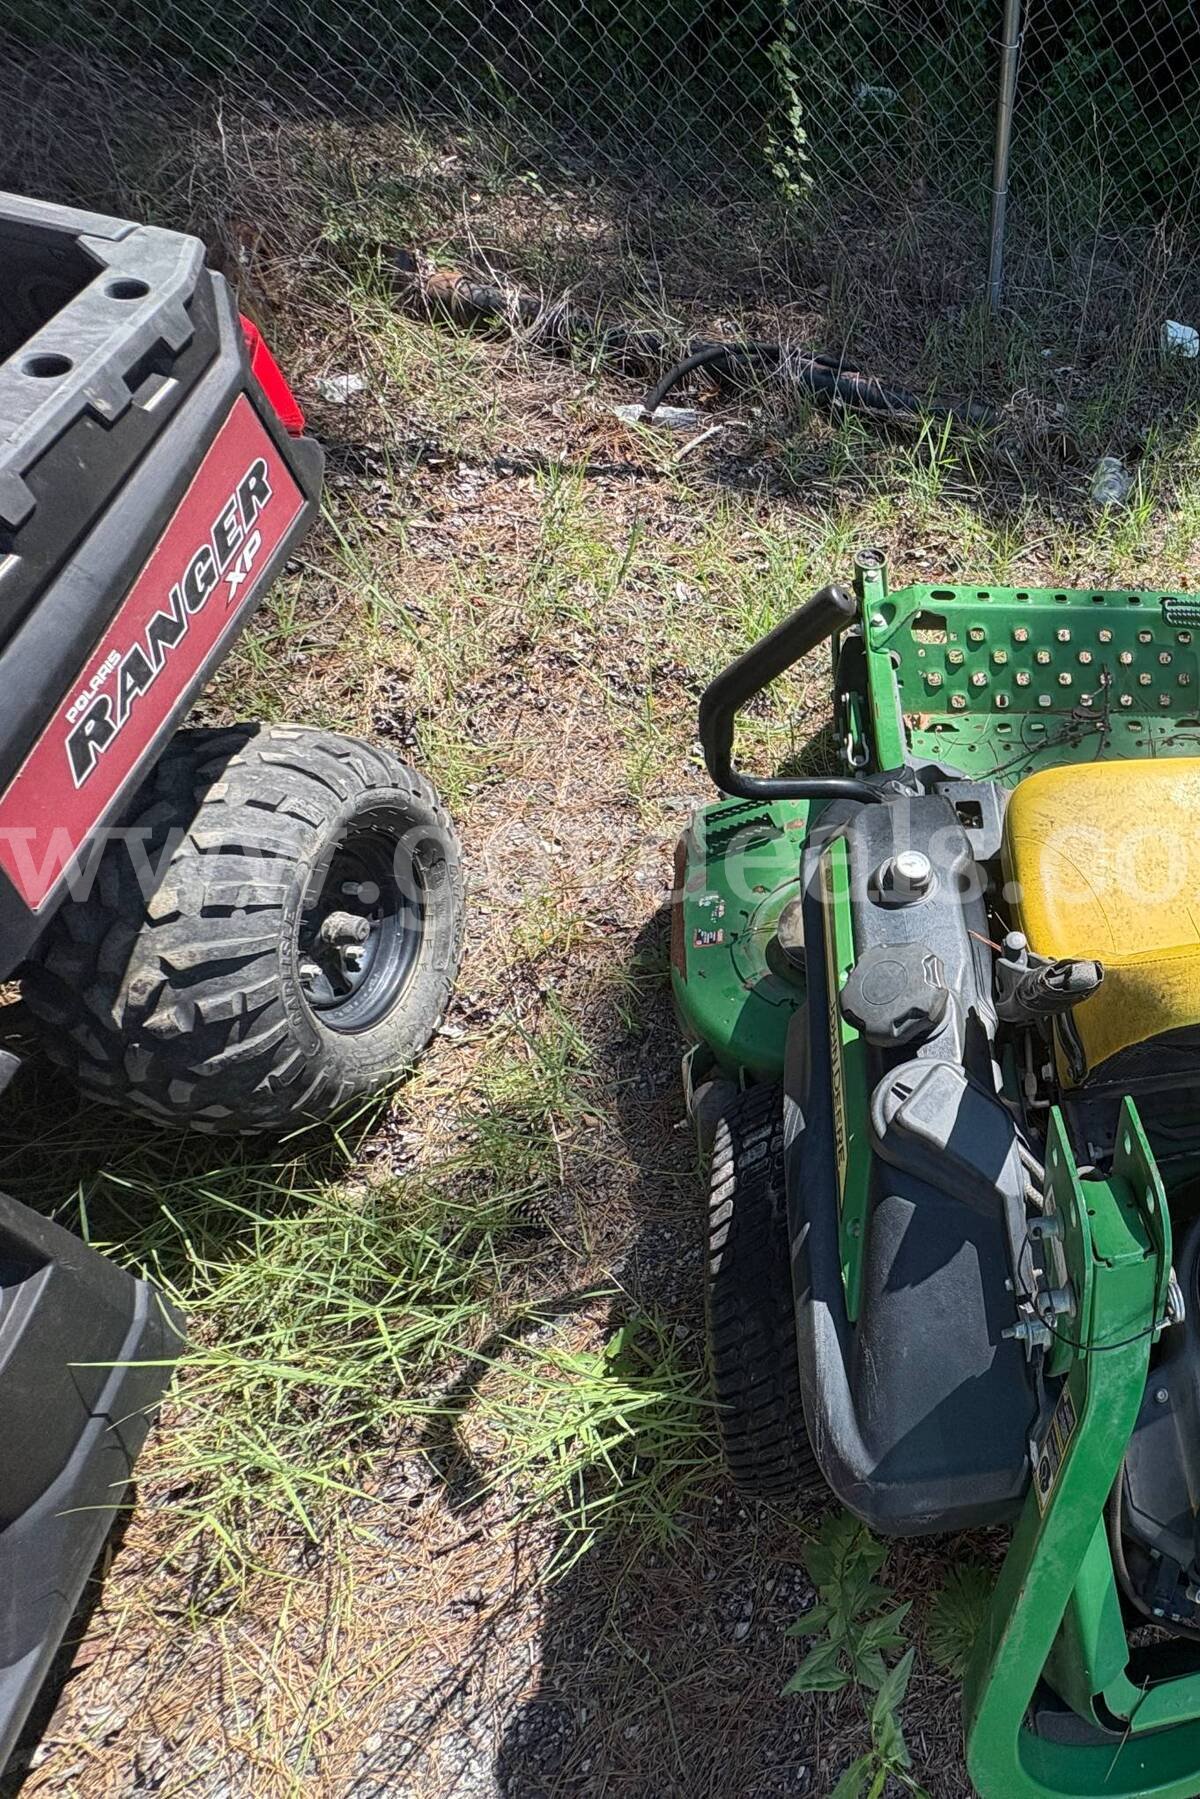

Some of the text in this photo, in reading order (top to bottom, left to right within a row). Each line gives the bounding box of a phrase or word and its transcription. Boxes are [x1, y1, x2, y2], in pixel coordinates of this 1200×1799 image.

[65, 457, 272, 789] RANGER
[225, 529, 262, 608] XP
[65, 650, 121, 724] POLARIS
[280, 909, 302, 1028] CARLISLE
[829, 1003, 846, 1163] JOHN DEERE
